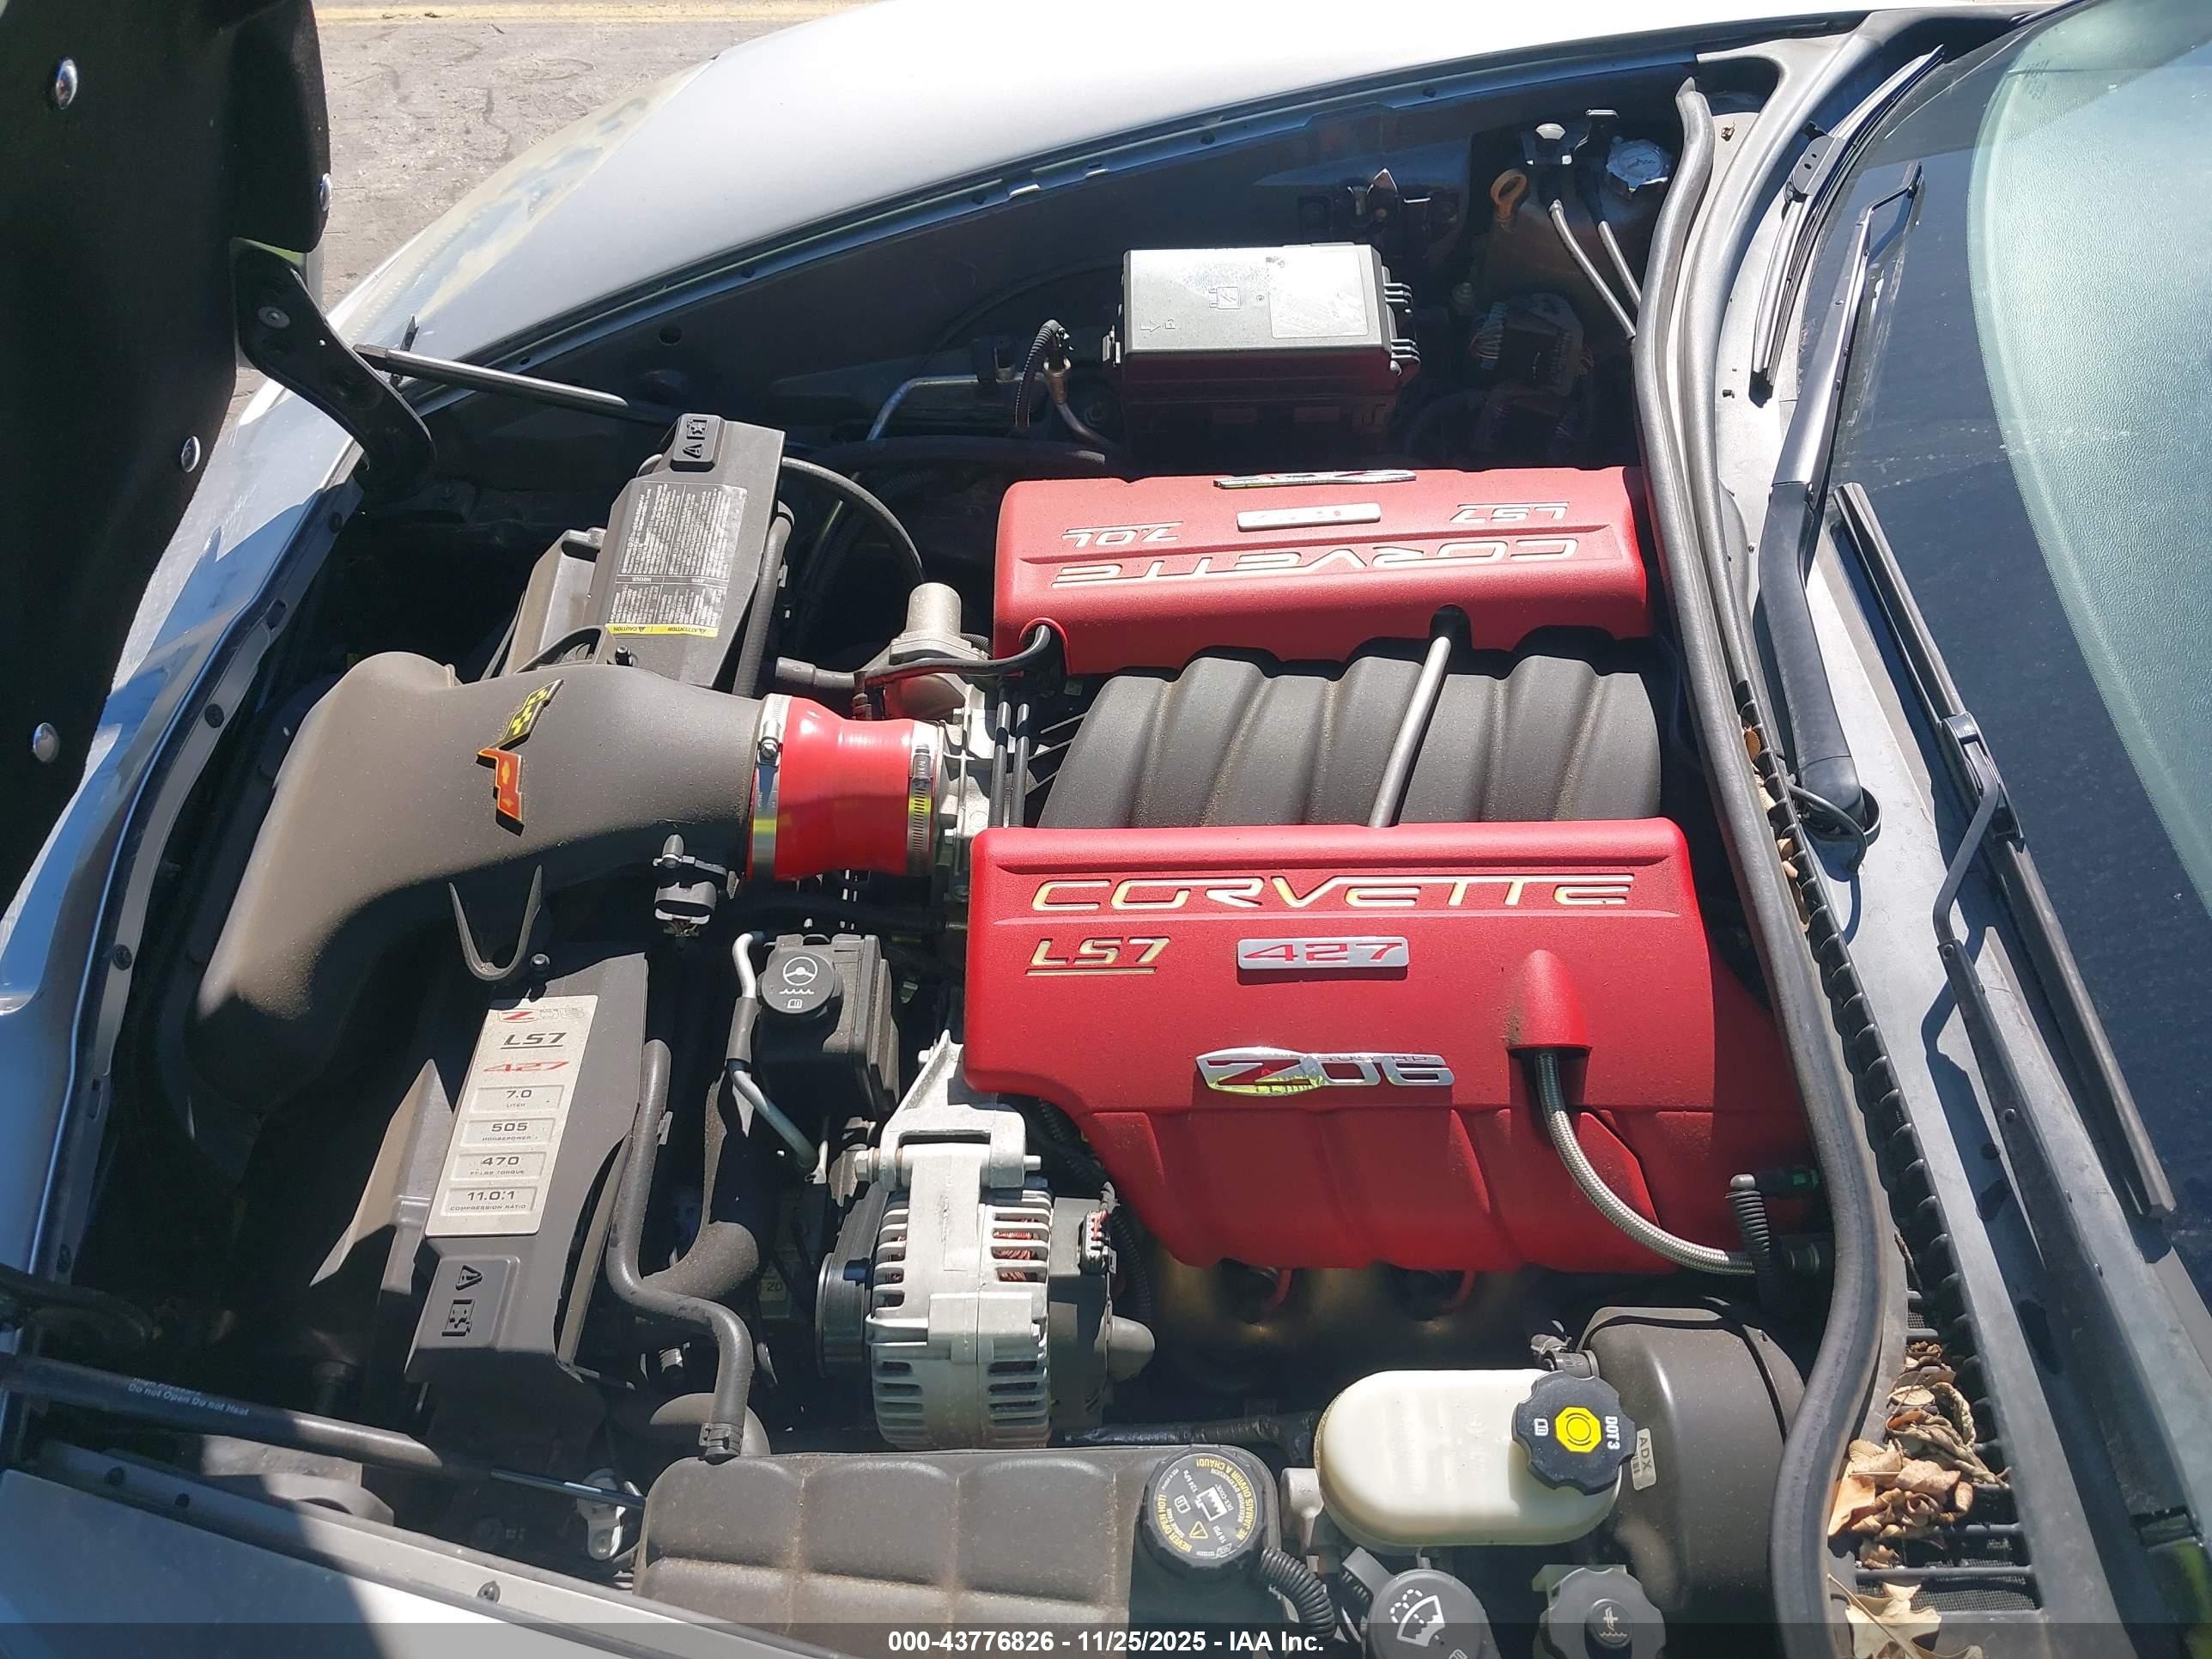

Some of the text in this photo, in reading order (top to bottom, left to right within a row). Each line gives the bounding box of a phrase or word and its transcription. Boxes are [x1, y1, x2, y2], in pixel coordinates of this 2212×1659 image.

[1449, 505, 1570, 525] LS7
[1060, 526, 1181, 548] 7.0L
[1051, 538, 1579, 588] CORVETTE
[1030, 874, 1635, 911] CORVETTE
[1030, 936, 1171, 966] LS7
[1243, 942, 1403, 963] 427
[503, 1032, 567, 1047] LS7
[483, 1060, 571, 1073] 427
[1195, 1046, 1455, 1097] Z06
[506, 1089, 532, 1099] 7.0
[491, 1121, 528, 1132] 505
[482, 1156, 520, 1166] 470
[467, 1190, 515, 1200] 11.0:1
[128, 1382, 250, 1416] Do not Open Do not Heat
[1605, 1416, 1620, 1450] DOT 3
[1195, 1459, 1224, 1469] CHAUD!
[1639, 1436, 1652, 1470] ADX
[1232, 1470, 1252, 1500] OUVRIR
[1243, 1498, 1255, 1529] JAMAIS
[1169, 1531, 1193, 1553] NEVER
